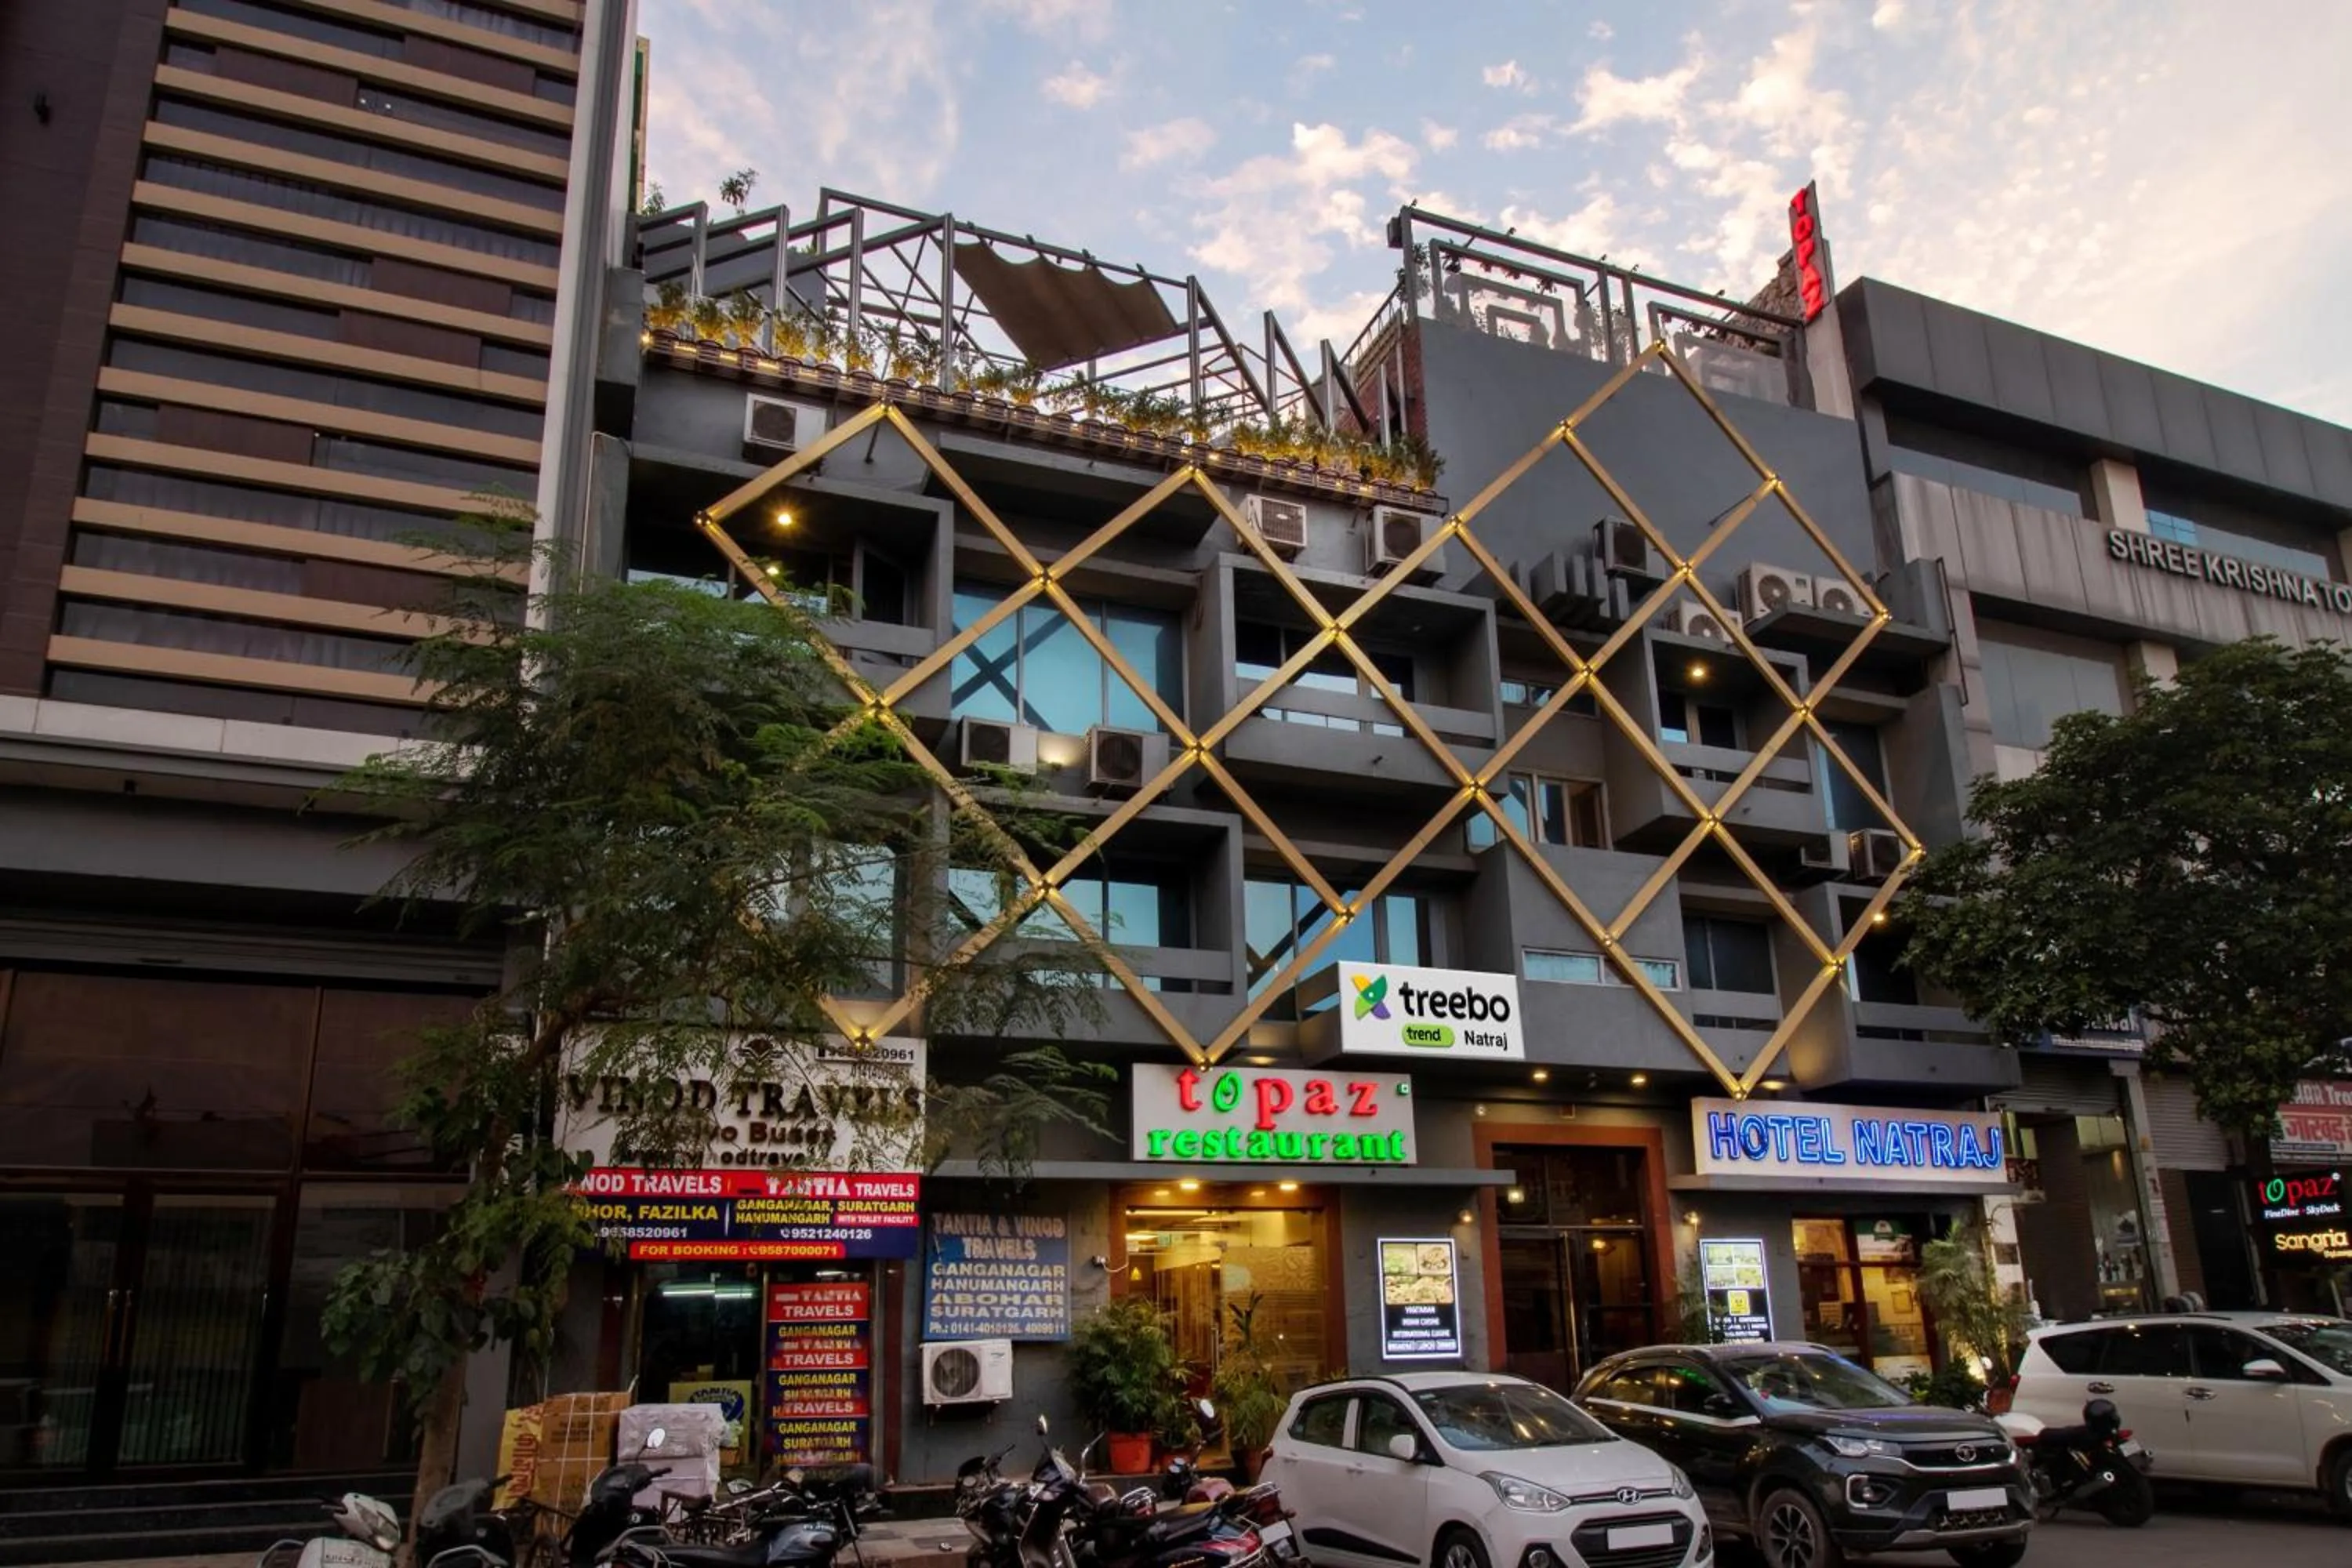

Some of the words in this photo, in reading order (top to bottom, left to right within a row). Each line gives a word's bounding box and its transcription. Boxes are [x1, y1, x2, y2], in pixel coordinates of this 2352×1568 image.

[1791, 188, 1823, 321] TOPAZ
[2109, 530, 2199, 578] SHREE
[2202, 553, 2318, 604] KRISHNA
[2318, 581, 2352, 613] TO
[1399, 982, 1511, 1022] treebo
[1406, 1027, 1442, 1042] trend
[1465, 1030, 1508, 1051] Natraj
[1177, 1068, 1381, 1131] topaz
[1147, 1126, 1406, 1160] restaurant
[1709, 1112, 1845, 1163] HOTEL
[1853, 1119, 2002, 1169] NATRAJ
[631, 1174, 722, 1194] TRAVELS
[855, 1182, 916, 1198] TRAVELS
[639, 1205, 719, 1220] FAZILKA
[837, 1200, 915, 1213] SURATGARH
[735, 1214, 830, 1225] HANUMANGARH
[791, 1228, 873, 1240] 9521240126
[2274, 1229, 2349, 1252] Sangria
[639, 1246, 670, 1255] FOR
[673, 1246, 739, 1255] BOOKING
[962, 1237, 1037, 1260] TRAVELS
[931, 1261, 1065, 1277] GANGANAGAR
[931, 1278, 1065, 1292] HANUMANGARH
[931, 1293, 1065, 1305] ABOHAR
[783, 1304, 855, 1318] TRAVELS
[930, 1305, 1065, 1319] SURATGARH
[779, 1324, 857, 1338] GANGANAGAR
[783, 1352, 855, 1366] TRAVELS
[779, 1373, 857, 1386] GANGANAGAR
[783, 1401, 855, 1414] TRAVELS
[779, 1421, 857, 1435] GANGANAGAR
